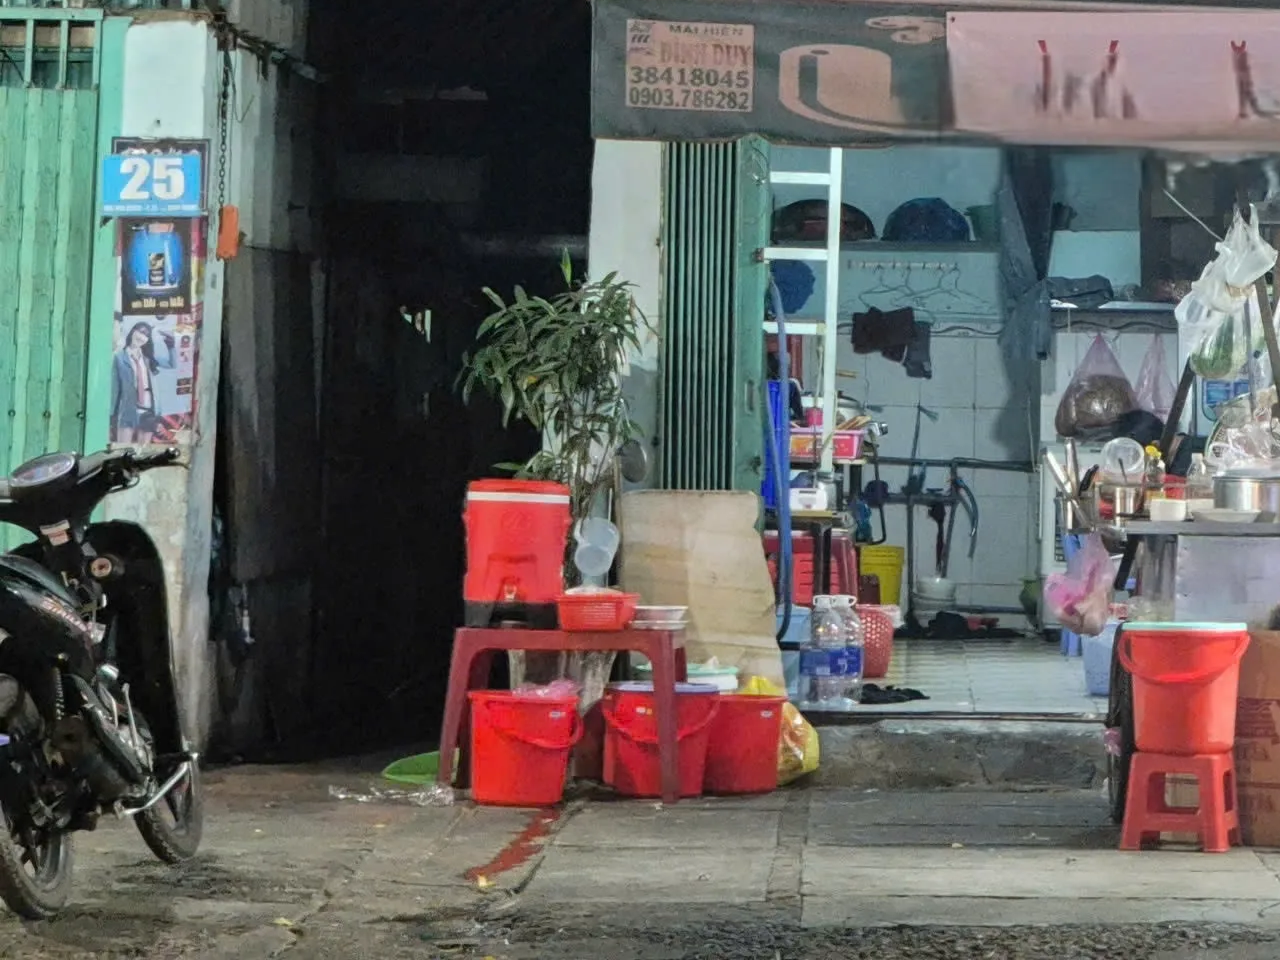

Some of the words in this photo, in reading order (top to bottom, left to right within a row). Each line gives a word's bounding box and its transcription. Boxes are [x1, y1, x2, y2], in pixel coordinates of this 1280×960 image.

[629, 66, 750, 89] 38418045
[628, 86, 749, 111] 0903.786282
[119, 157, 185, 201] 25
